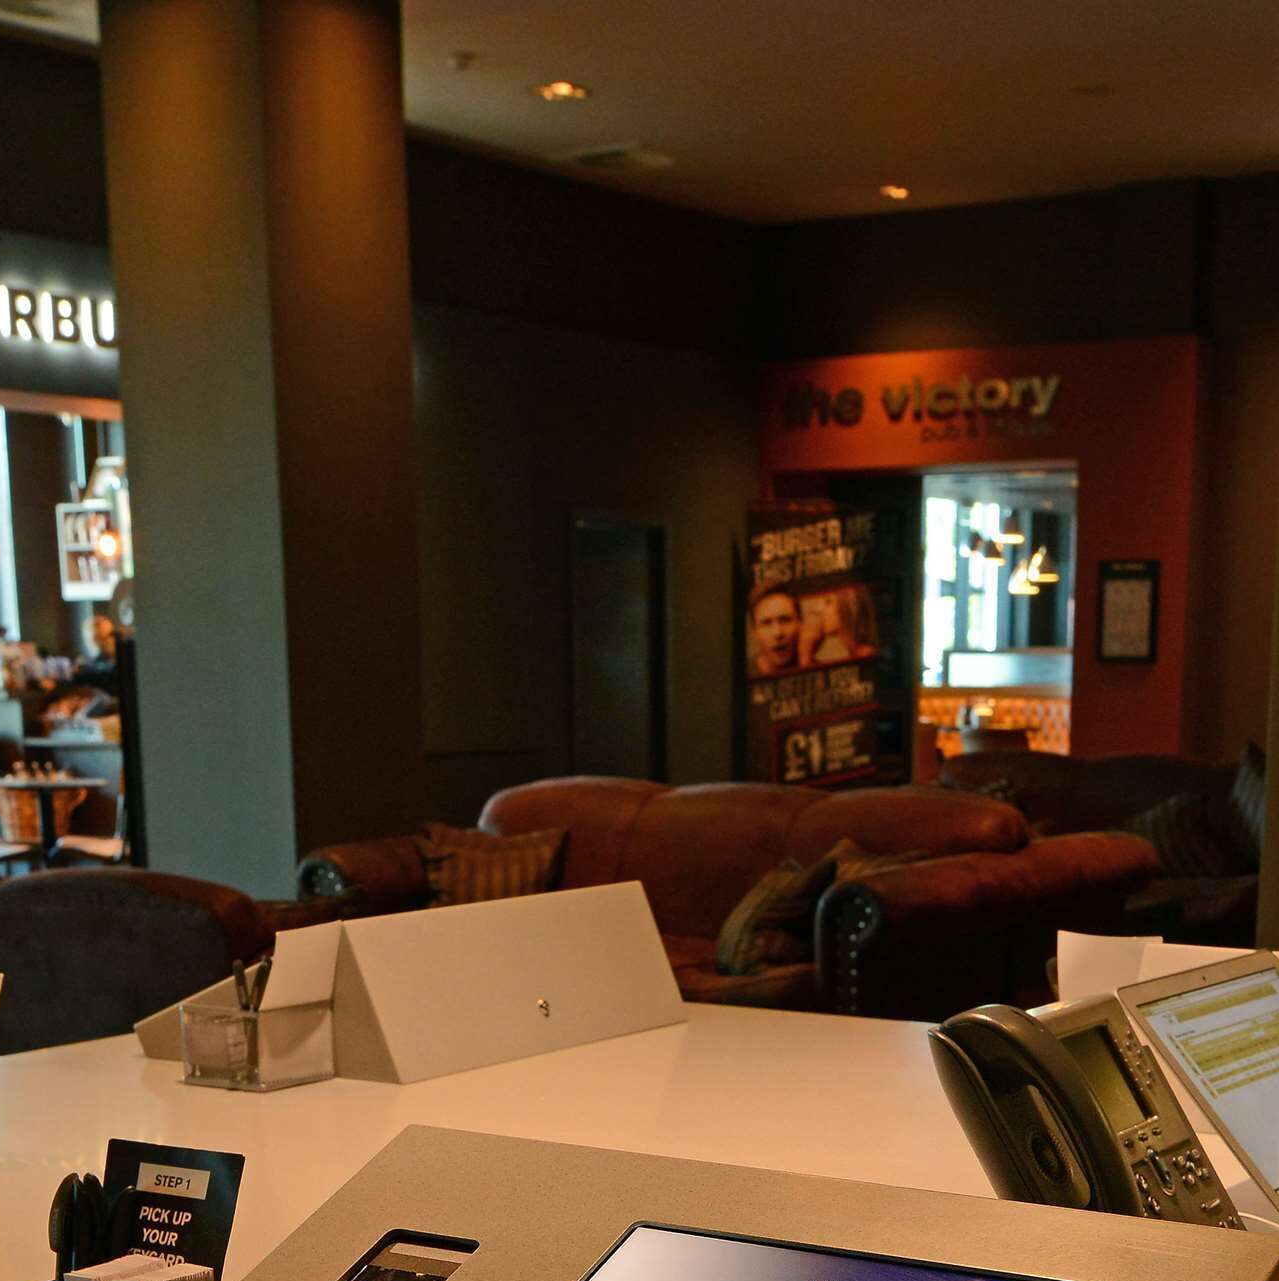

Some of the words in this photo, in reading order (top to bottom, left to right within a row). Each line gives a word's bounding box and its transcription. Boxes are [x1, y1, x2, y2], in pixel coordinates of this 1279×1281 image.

[785, 381, 862, 429] the
[882, 373, 1061, 420] victory
[784, 730, 822, 781] £1
[154, 1174, 183, 1188] STEP
[186, 1179, 191, 1190] 1
[138, 1206, 169, 1223] PICK
[172, 1210, 192, 1227] UP
[142, 1227, 178, 1246] YOUR
[128, 1248, 185, 1267] EYCARD
